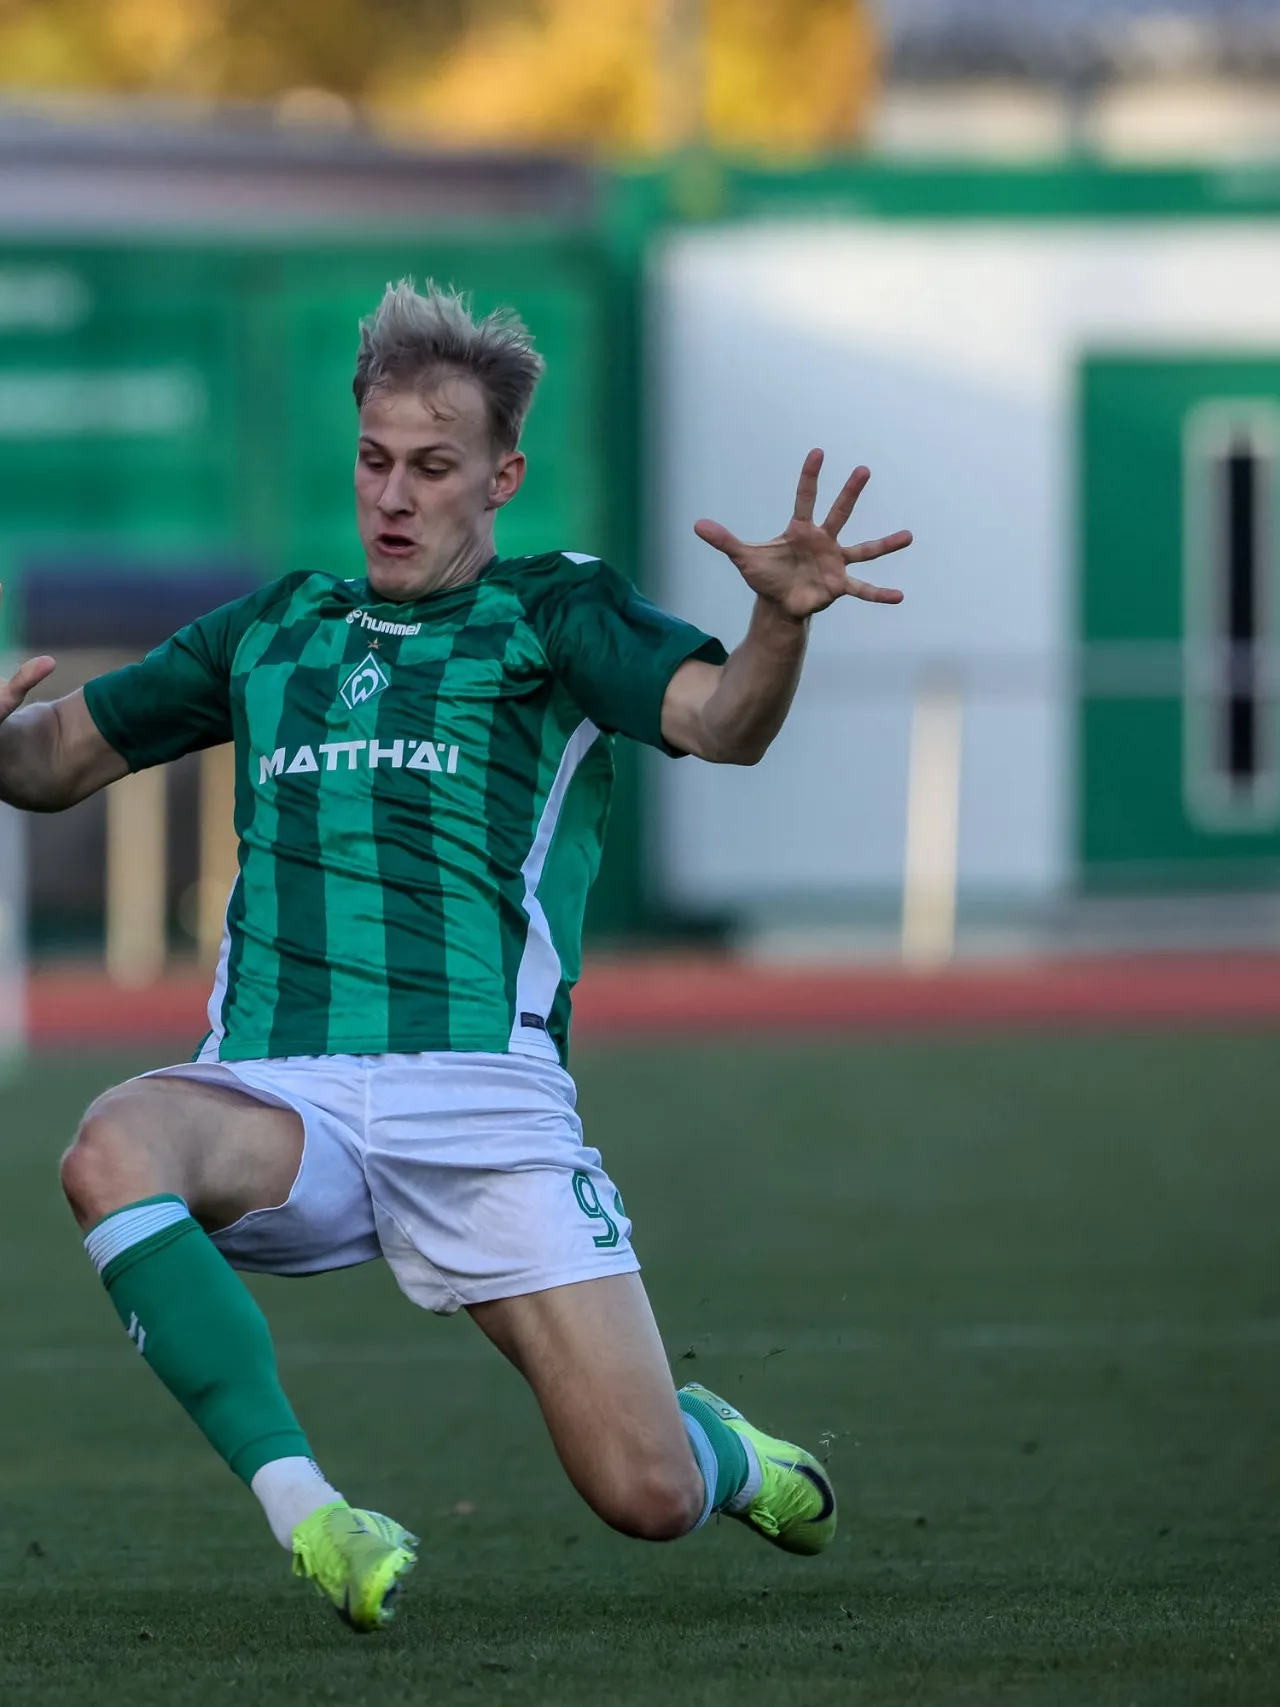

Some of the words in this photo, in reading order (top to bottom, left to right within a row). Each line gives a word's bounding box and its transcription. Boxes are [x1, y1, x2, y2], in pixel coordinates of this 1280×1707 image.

[360, 611, 422, 636] hummel
[258, 739, 460, 785] MATTHÄI
[571, 1169, 620, 1248] 9
